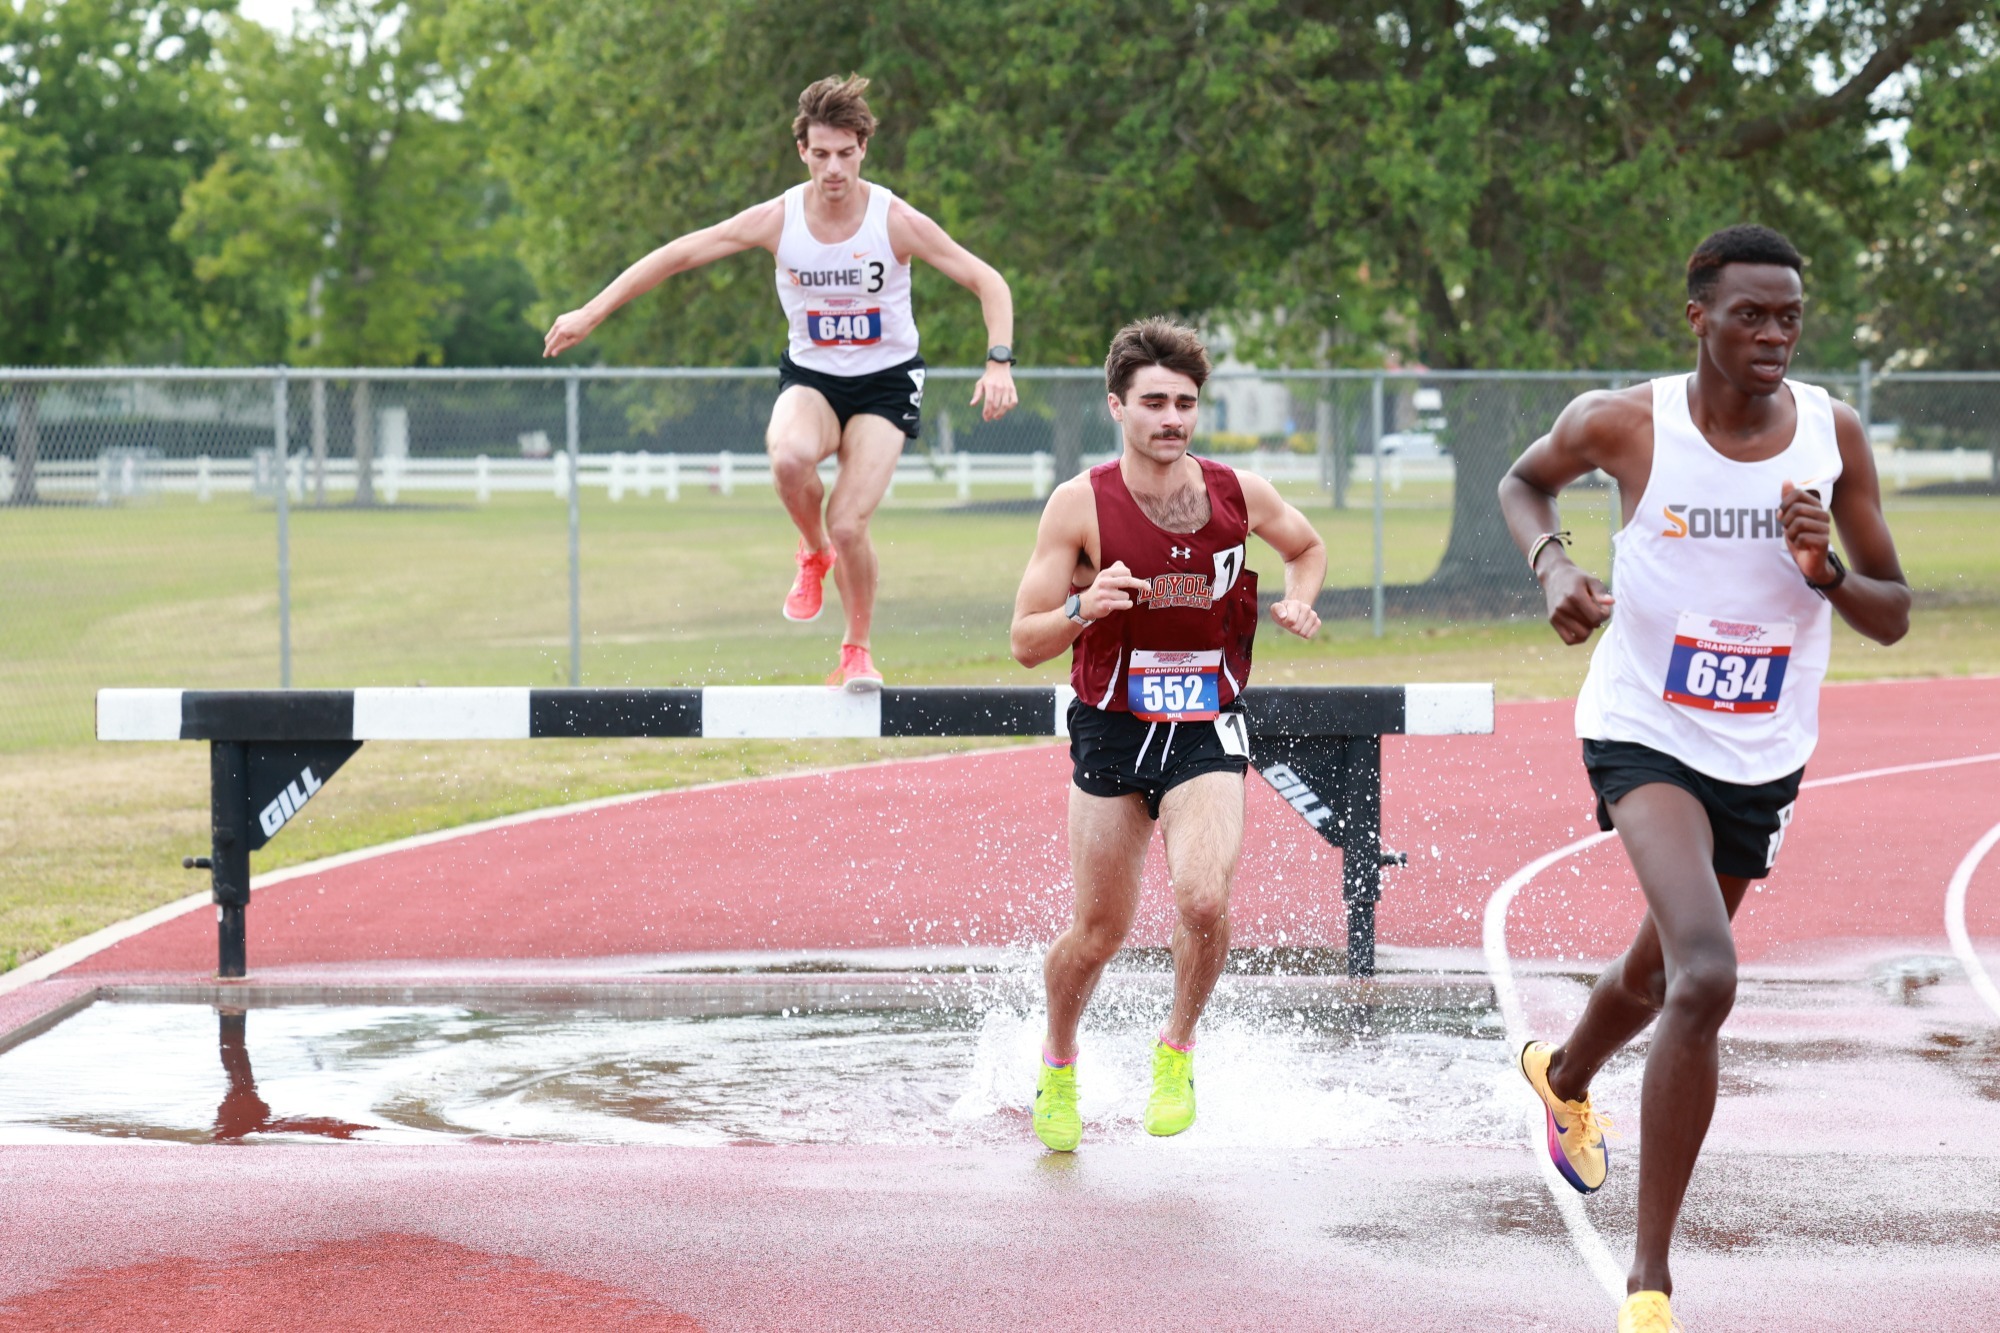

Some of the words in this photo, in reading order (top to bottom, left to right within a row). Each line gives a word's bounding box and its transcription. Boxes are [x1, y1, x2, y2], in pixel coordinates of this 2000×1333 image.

[786, 268, 862, 287] SOUTHE
[867, 261, 885, 293] 3
[818, 315, 871, 341] 640
[1138, 574, 1214, 602] LOYOL
[1696, 640, 1773, 655] CHAMPIONSHIP
[1144, 667, 1203, 675] CHAMPIONSHIP
[1686, 651, 1771, 701] 634
[1142, 675, 1205, 712] 552
[259, 766, 322, 838] GILL
[1262, 763, 1334, 828] GILL
